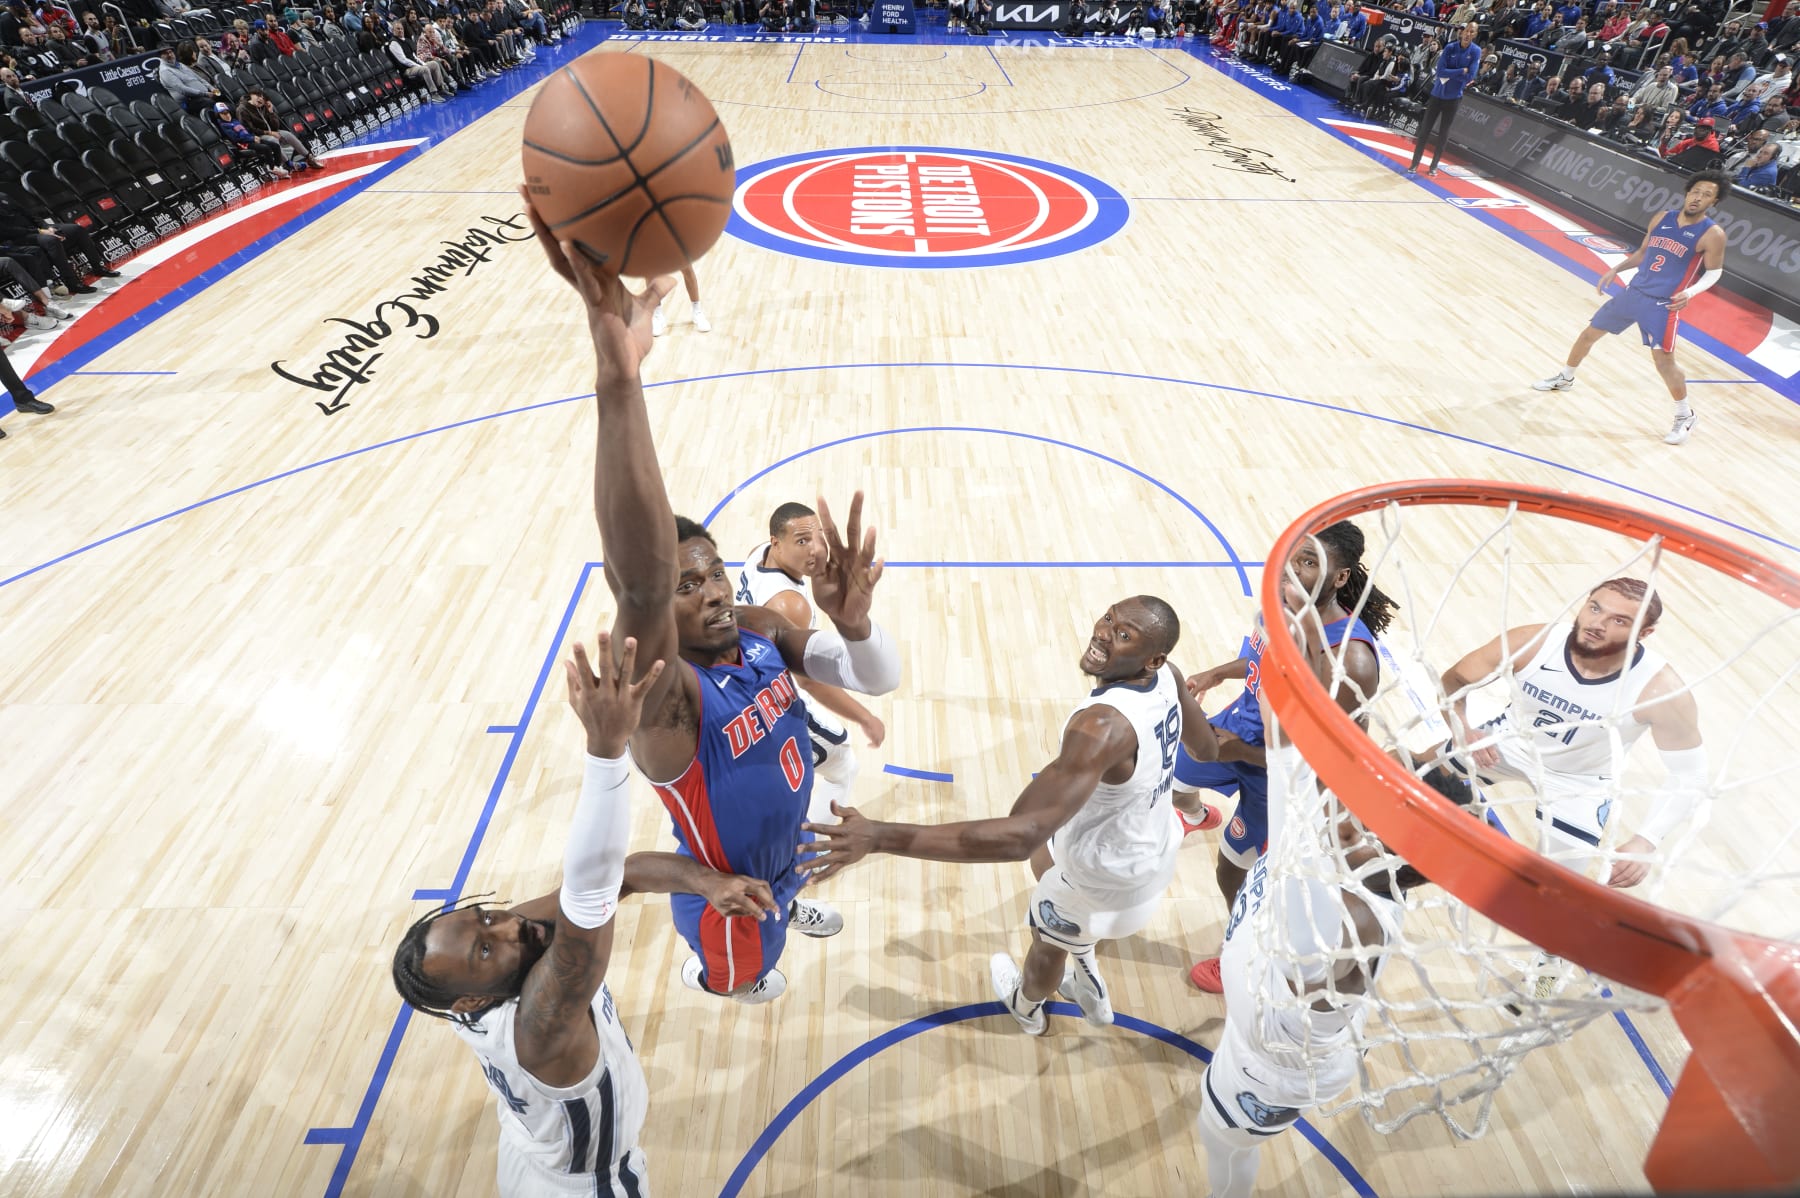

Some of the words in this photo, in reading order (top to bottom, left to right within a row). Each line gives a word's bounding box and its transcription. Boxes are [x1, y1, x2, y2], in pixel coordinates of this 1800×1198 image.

[100, 71, 118, 83] Little
[115, 65, 142, 79] Caesars
[125, 75, 146, 87] arena
[1510, 130, 1550, 161] THE
[1540, 143, 1595, 182] KING
[1588, 163, 1627, 192] OF
[218, 180, 235, 194] Little
[238, 172, 255, 185] Little
[240, 178, 261, 193] Caesars
[198, 190, 216, 203] Little
[221, 186, 243, 202] Caesars
[850, 163, 916, 236] PISTONS
[917, 165, 991, 236] DETROIT
[177, 201, 196, 215] Little
[200, 197, 223, 212] Caesars
[152, 212, 172, 227] Little
[180, 208, 203, 225] Caesars
[126, 224, 147, 239] Little
[154, 219, 181, 236] Caesars
[100, 236, 124, 251] Little
[129, 232, 157, 250] Caesars
[1649, 236, 1689, 258] DETROIT
[103, 244, 133, 262] Caesars
[1649, 254, 1666, 272] 2
[271, 300, 440, 417] Equity
[1532, 709, 1580, 745] 21
[1154, 703, 1181, 771] 18
[779, 736, 806, 793] 0
